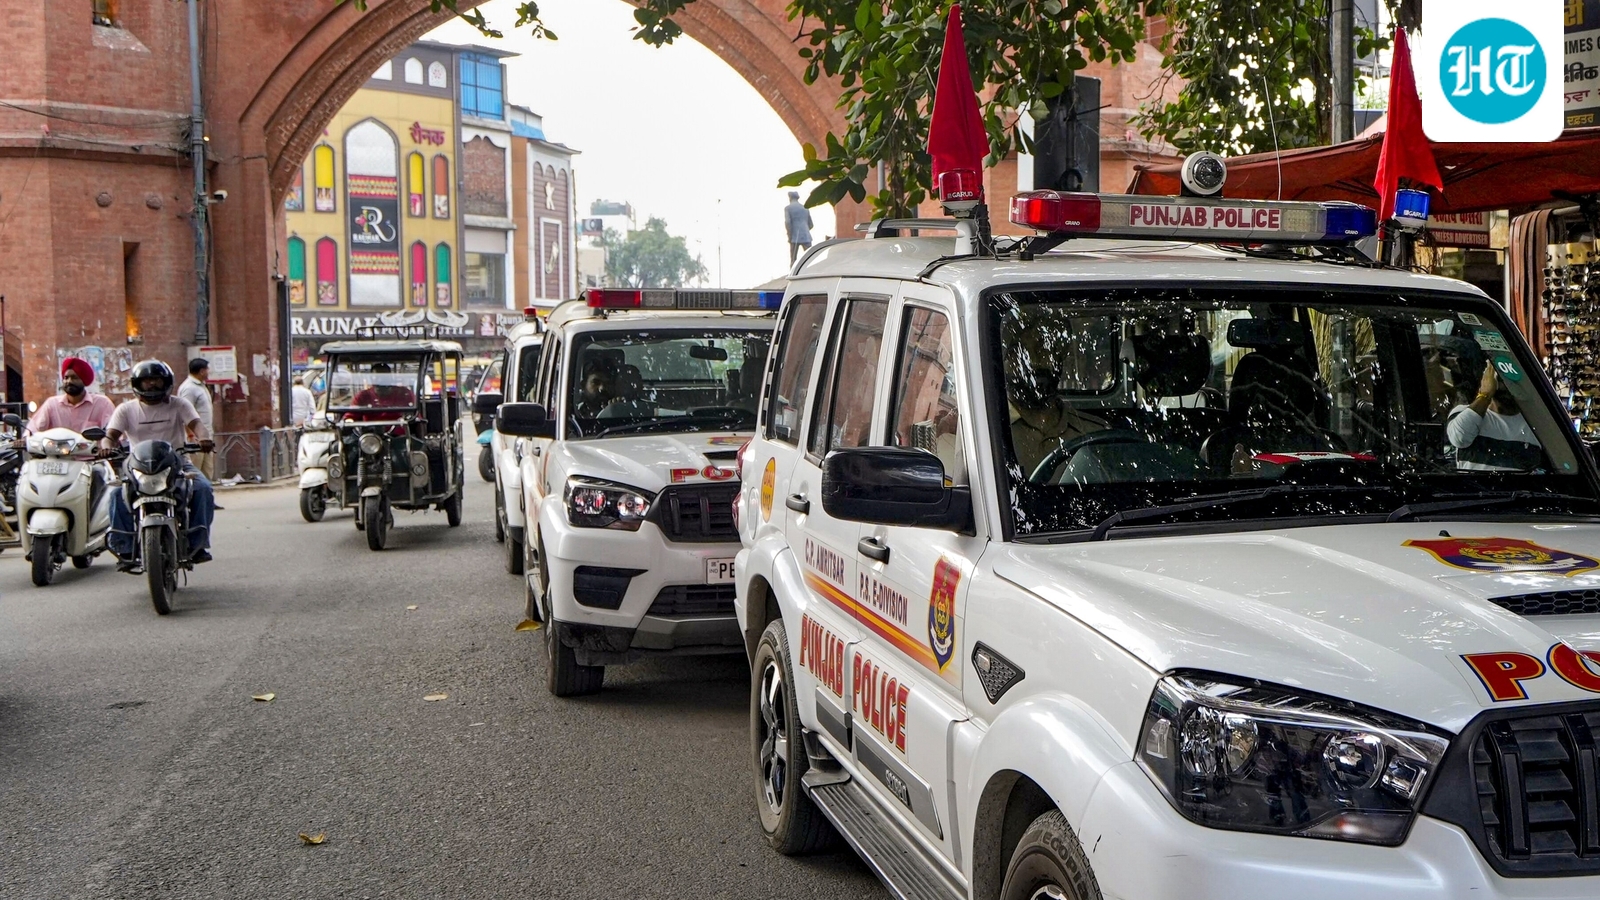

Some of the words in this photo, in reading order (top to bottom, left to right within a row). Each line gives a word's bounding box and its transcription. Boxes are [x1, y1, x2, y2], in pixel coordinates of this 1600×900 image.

[1564, 37, 1593, 55] IMES
[409, 121, 445, 147] रौनक
[1129, 205, 1208, 227] PUNJAB
[1213, 207, 1280, 229] POLICE
[291, 316, 378, 335] RAUNAK
[496, 314, 525, 326] Rauna
[1497, 361, 1519, 375] OK
[816, 545, 845, 586] AMRITSAR
[800, 612, 844, 699] PUNJAB
[852, 651, 910, 755] POLICE
